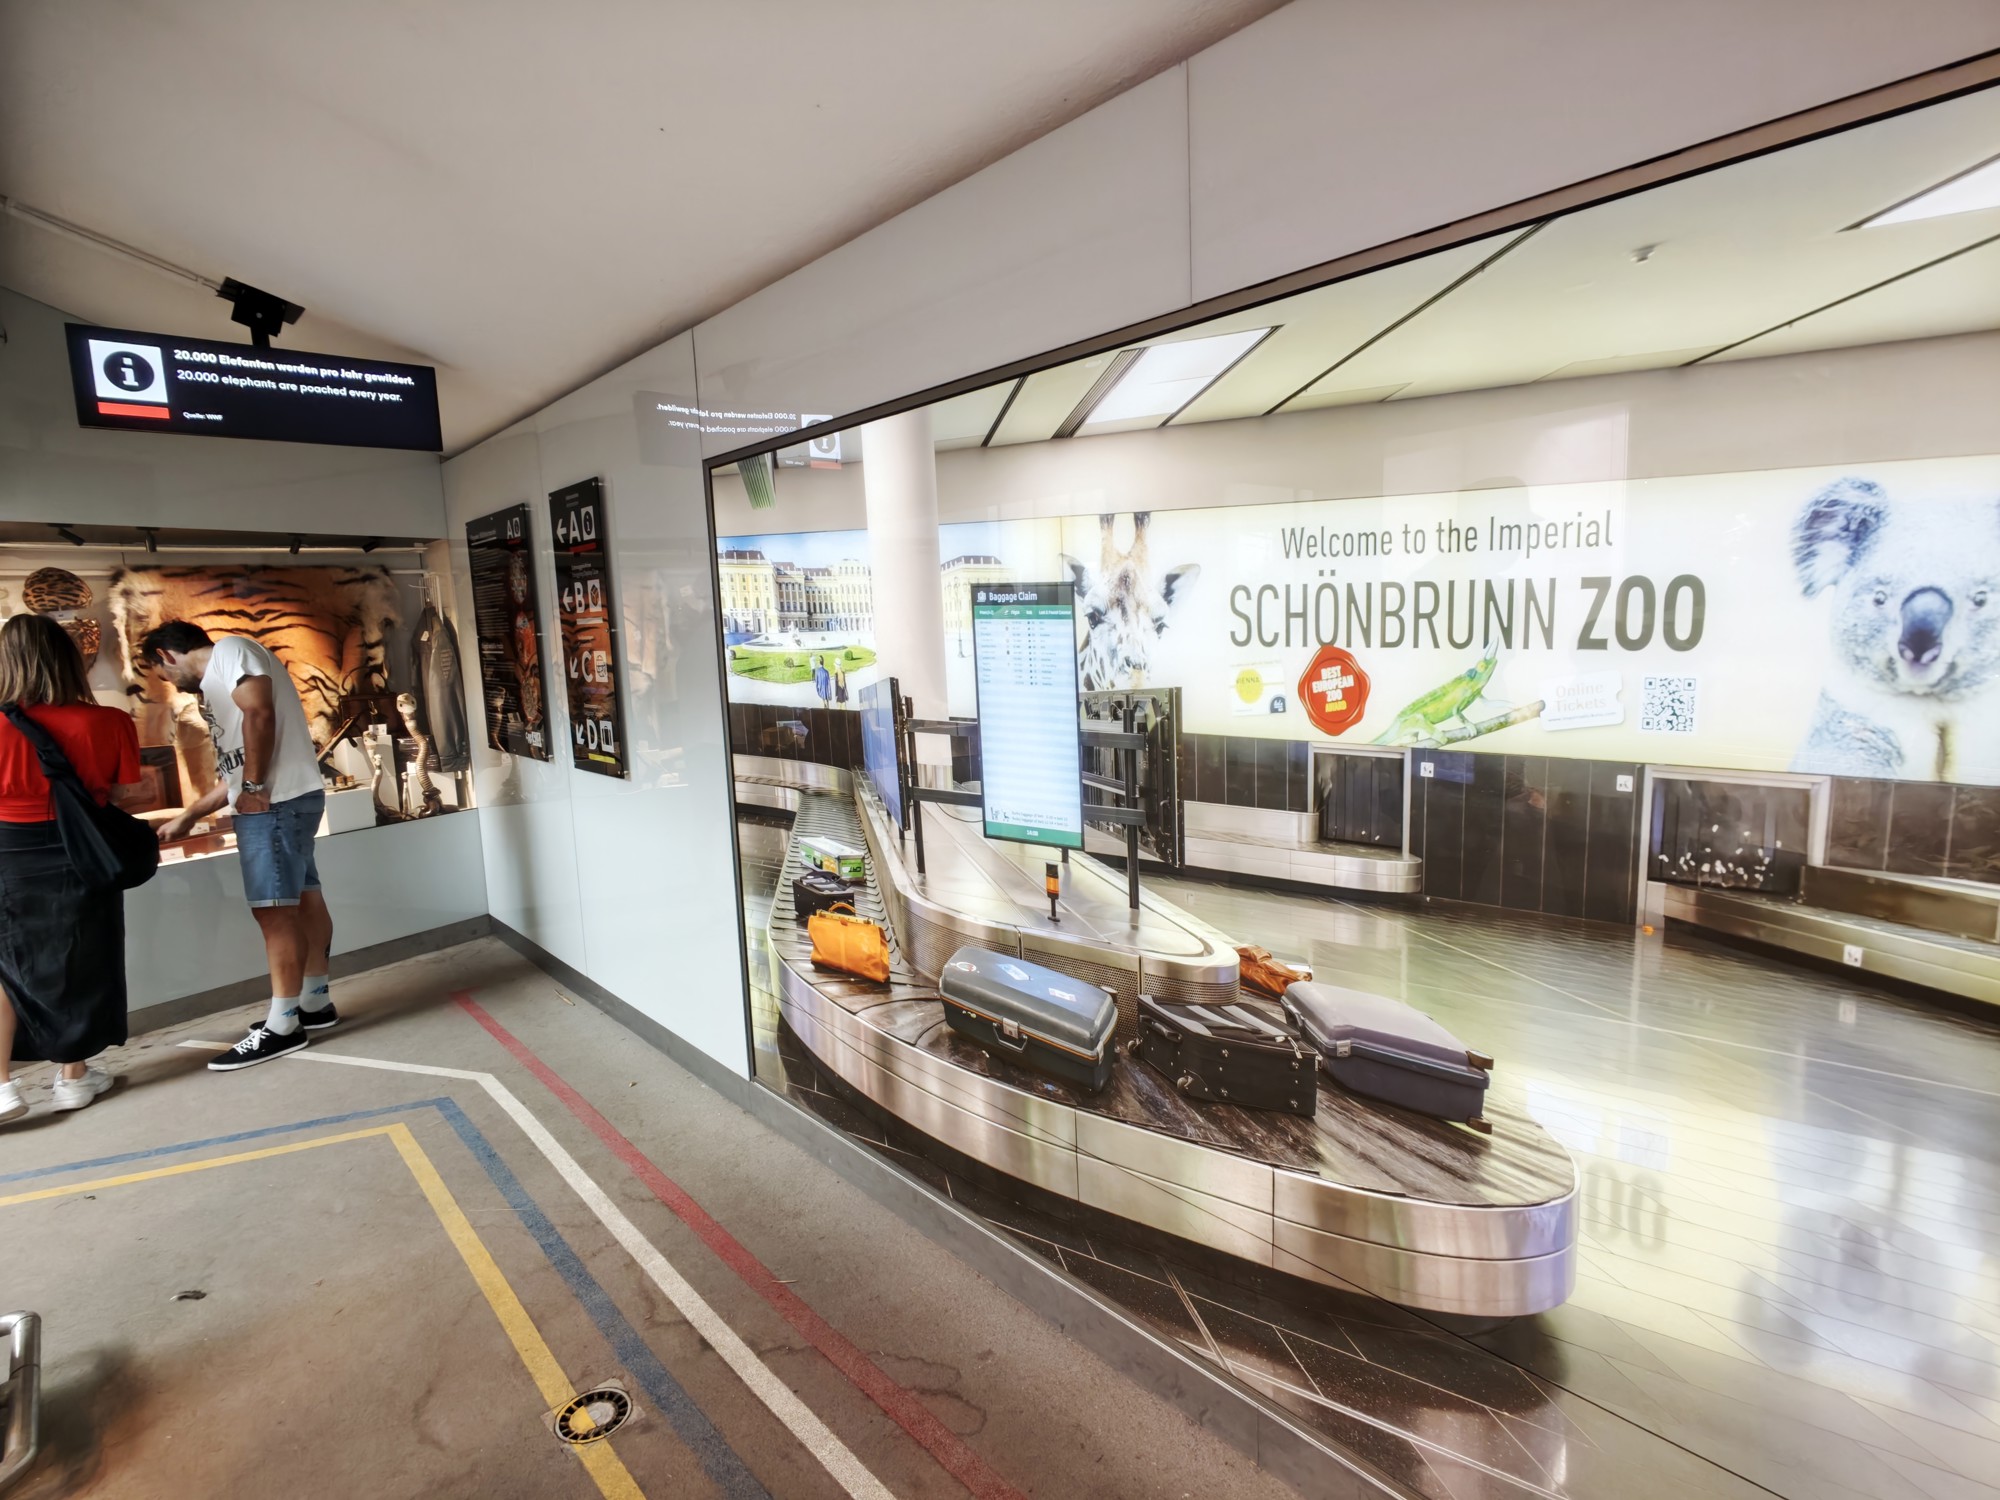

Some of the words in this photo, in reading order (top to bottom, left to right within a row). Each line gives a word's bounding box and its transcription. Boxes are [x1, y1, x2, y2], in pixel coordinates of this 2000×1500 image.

[173, 349, 217, 364] 20.000
[219, 354, 275, 371] Elefanten
[276, 362, 318, 375] werden
[320, 367, 339, 378] pro
[340, 369, 363, 380] Jahr
[364, 373, 415, 386] gewildert.
[176, 369, 219, 383] 20.000
[221, 375, 277, 389] elephants
[278, 382, 298, 391] are
[300, 384, 347, 397] poached
[349, 389, 376, 402] every
[378, 392, 403, 402] year.
[569, 510, 582, 544] A
[1281, 525, 1393, 559] Welcome
[1402, 523, 1426, 555] to
[1436, 517, 1478, 553] the
[1489, 510, 1613, 561] Imperial
[574, 581, 585, 614] B
[989, 592, 1017, 603] Baggage
[1018, 591, 1037, 601] Claim
[1229, 569, 1557, 650] SCHÖNBRUNN
[1577, 573, 1706, 652] ZOO
[581, 650, 593, 683] C
[1321, 665, 1341, 680] BEST
[1312, 675, 1354, 694] EUROPEAN
[1326, 688, 1342, 702] ZOO
[1556, 682, 1603, 698] Online
[1554, 698, 1606, 713] Tickets
[586, 718, 598, 750] D
